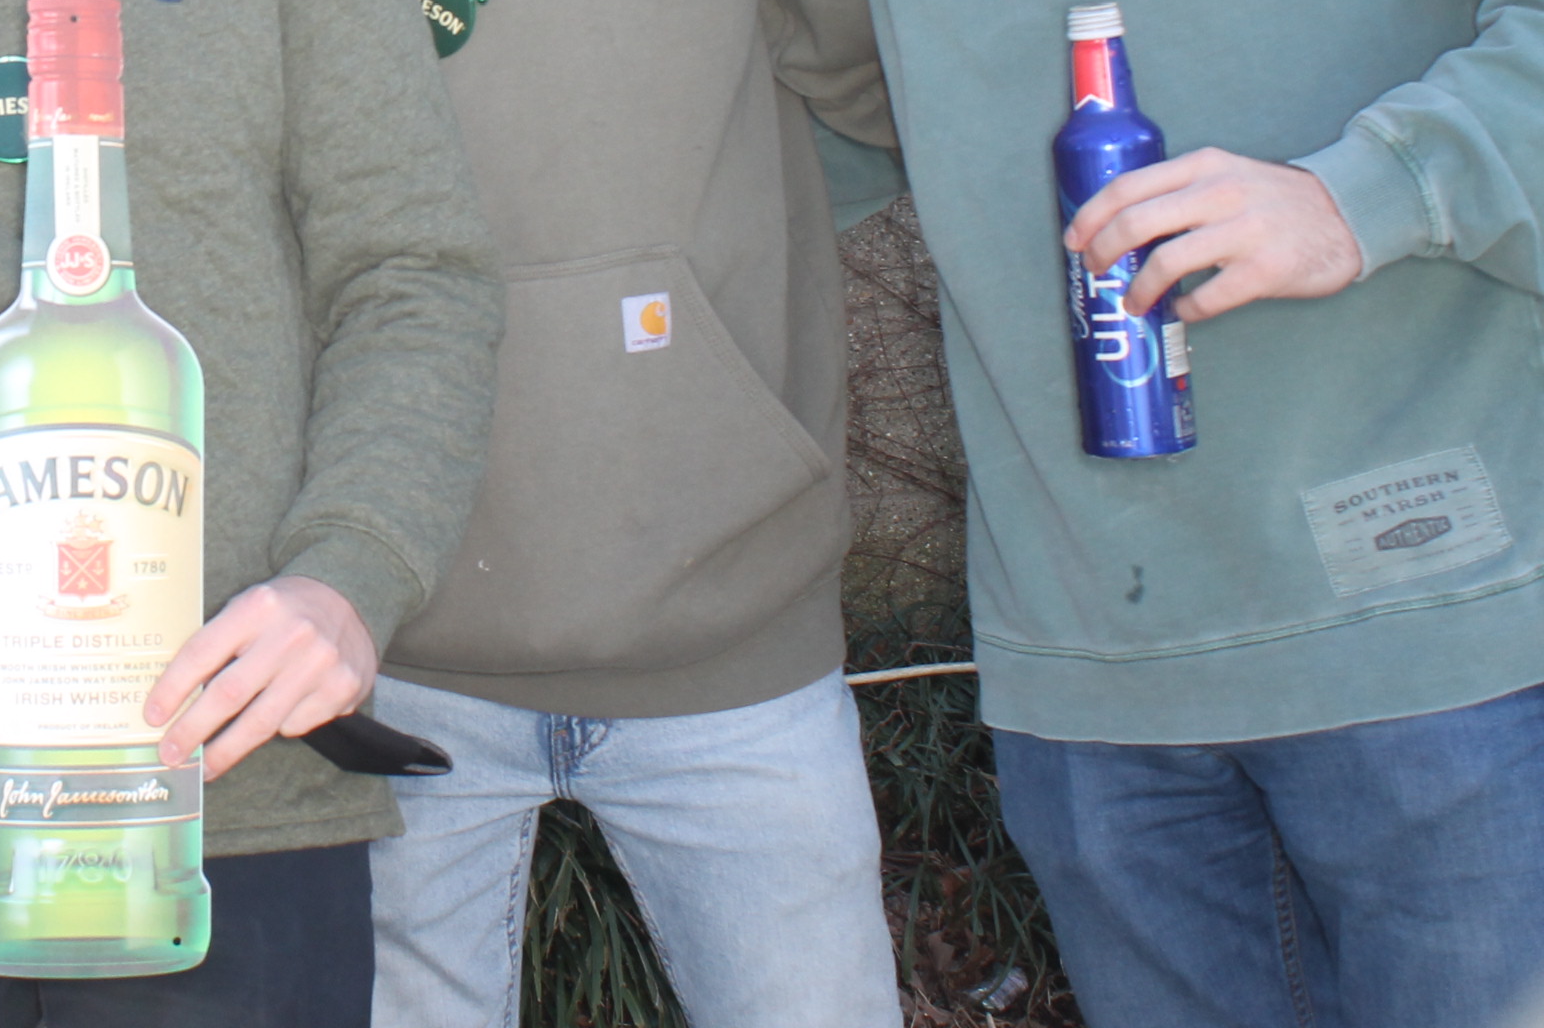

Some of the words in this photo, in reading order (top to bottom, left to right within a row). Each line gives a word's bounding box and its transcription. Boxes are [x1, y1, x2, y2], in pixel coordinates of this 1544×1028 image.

[1086, 272, 1130, 361] ULT
[1333, 469, 1461, 515] SOUTHERN
[1361, 490, 1446, 523] MARSH
[133, 560, 167, 575] 1780
[3, 635, 65, 650] TRIPLE
[71, 633, 164, 649] DISTILLED
[14, 692, 64, 706] IRISH
